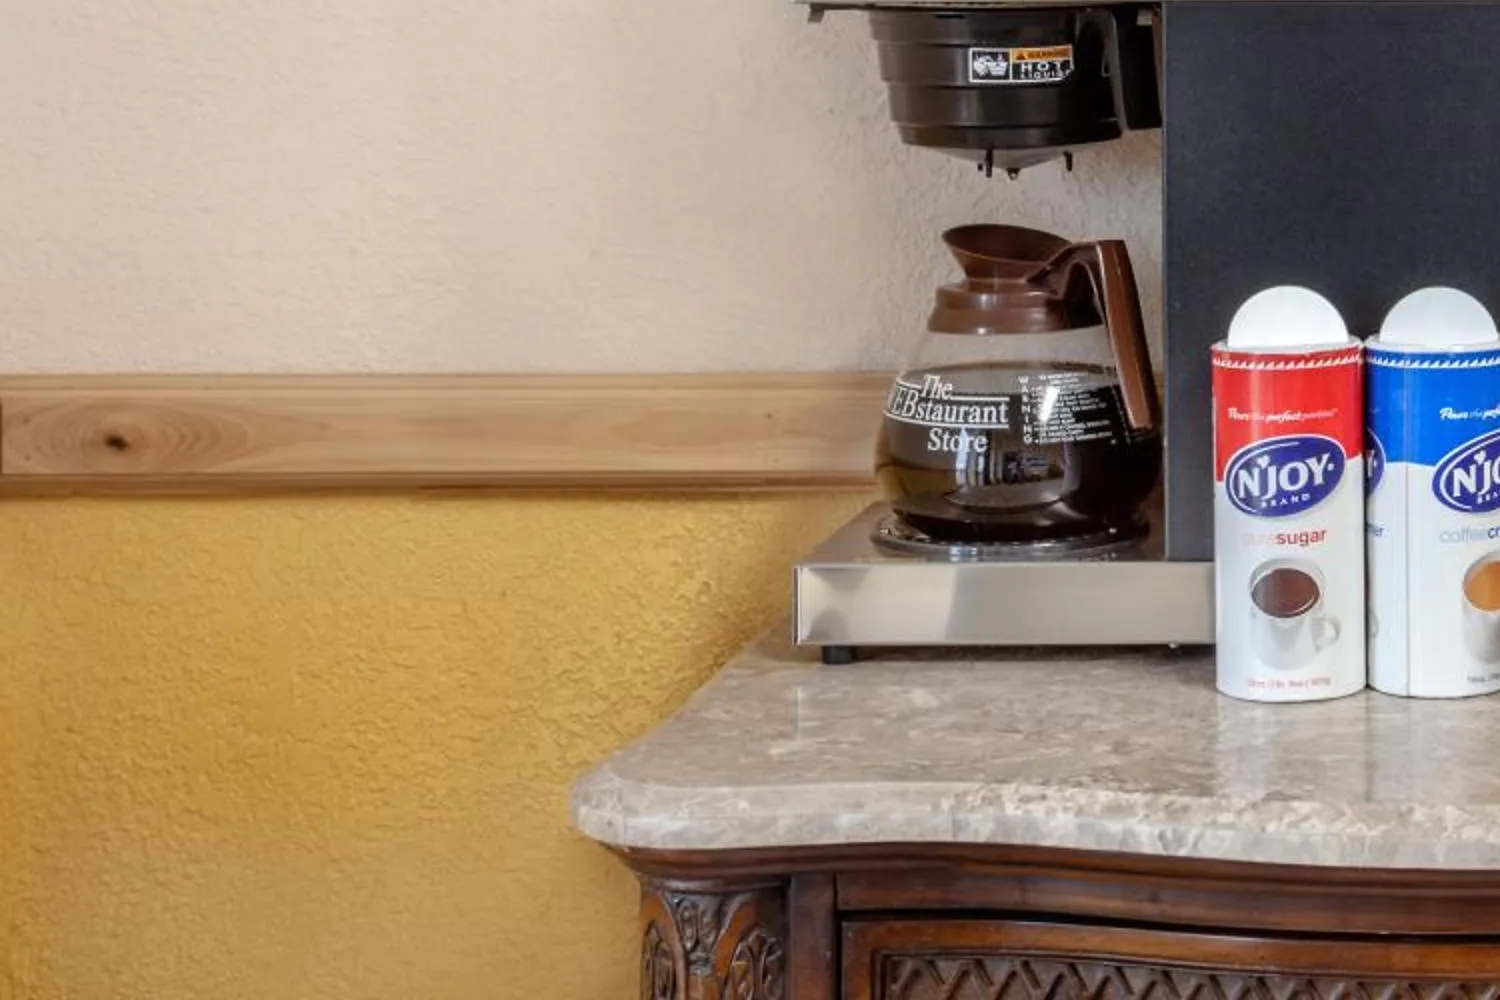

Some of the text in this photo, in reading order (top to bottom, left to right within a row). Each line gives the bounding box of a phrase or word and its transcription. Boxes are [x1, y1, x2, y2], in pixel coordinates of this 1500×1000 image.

[1021, 60, 1062, 72] HOT
[922, 374, 953, 400] The
[927, 427, 989, 453] Store
[1261, 493, 1311, 508] BRAND
